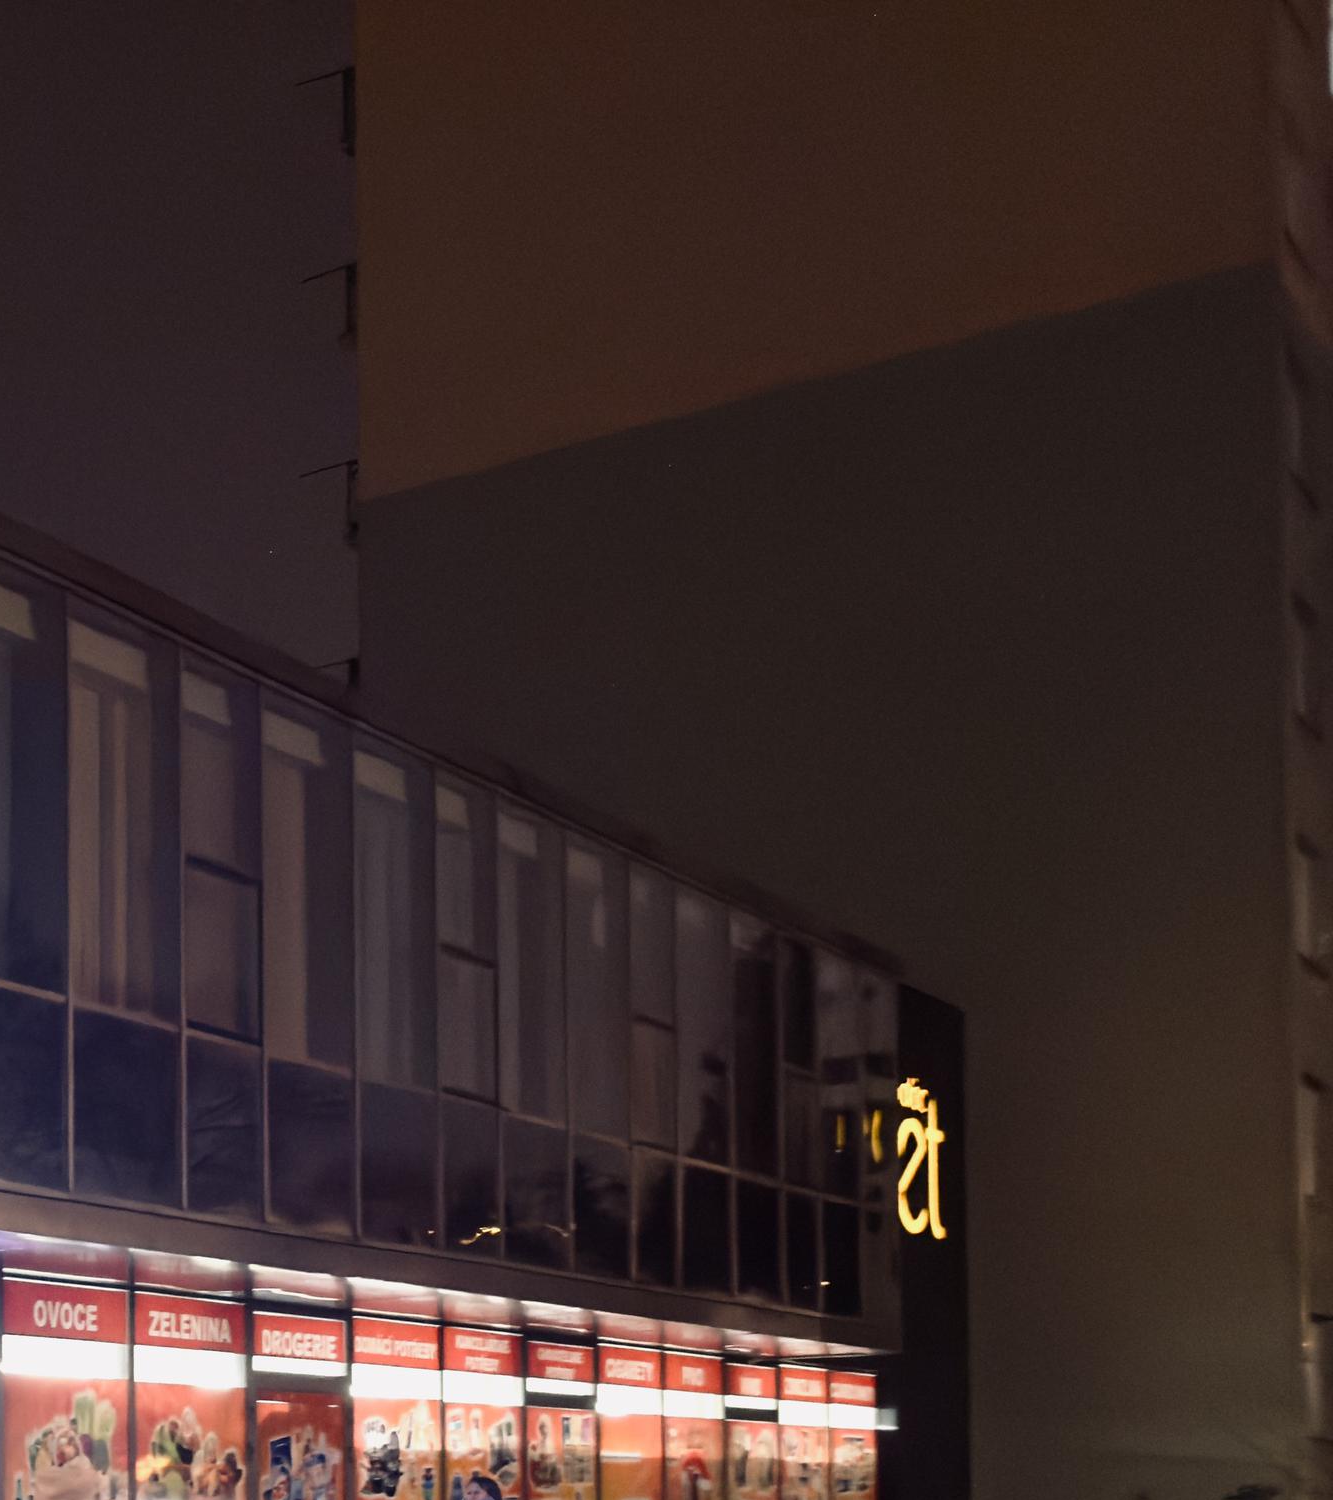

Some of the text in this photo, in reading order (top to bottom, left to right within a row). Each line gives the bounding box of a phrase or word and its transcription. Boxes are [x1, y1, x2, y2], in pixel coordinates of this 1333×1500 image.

[33, 1300, 99, 1331] OVOCE
[148, 1310, 231, 1343] ZELENINA
[261, 1329, 337, 1358] DROGERIE
